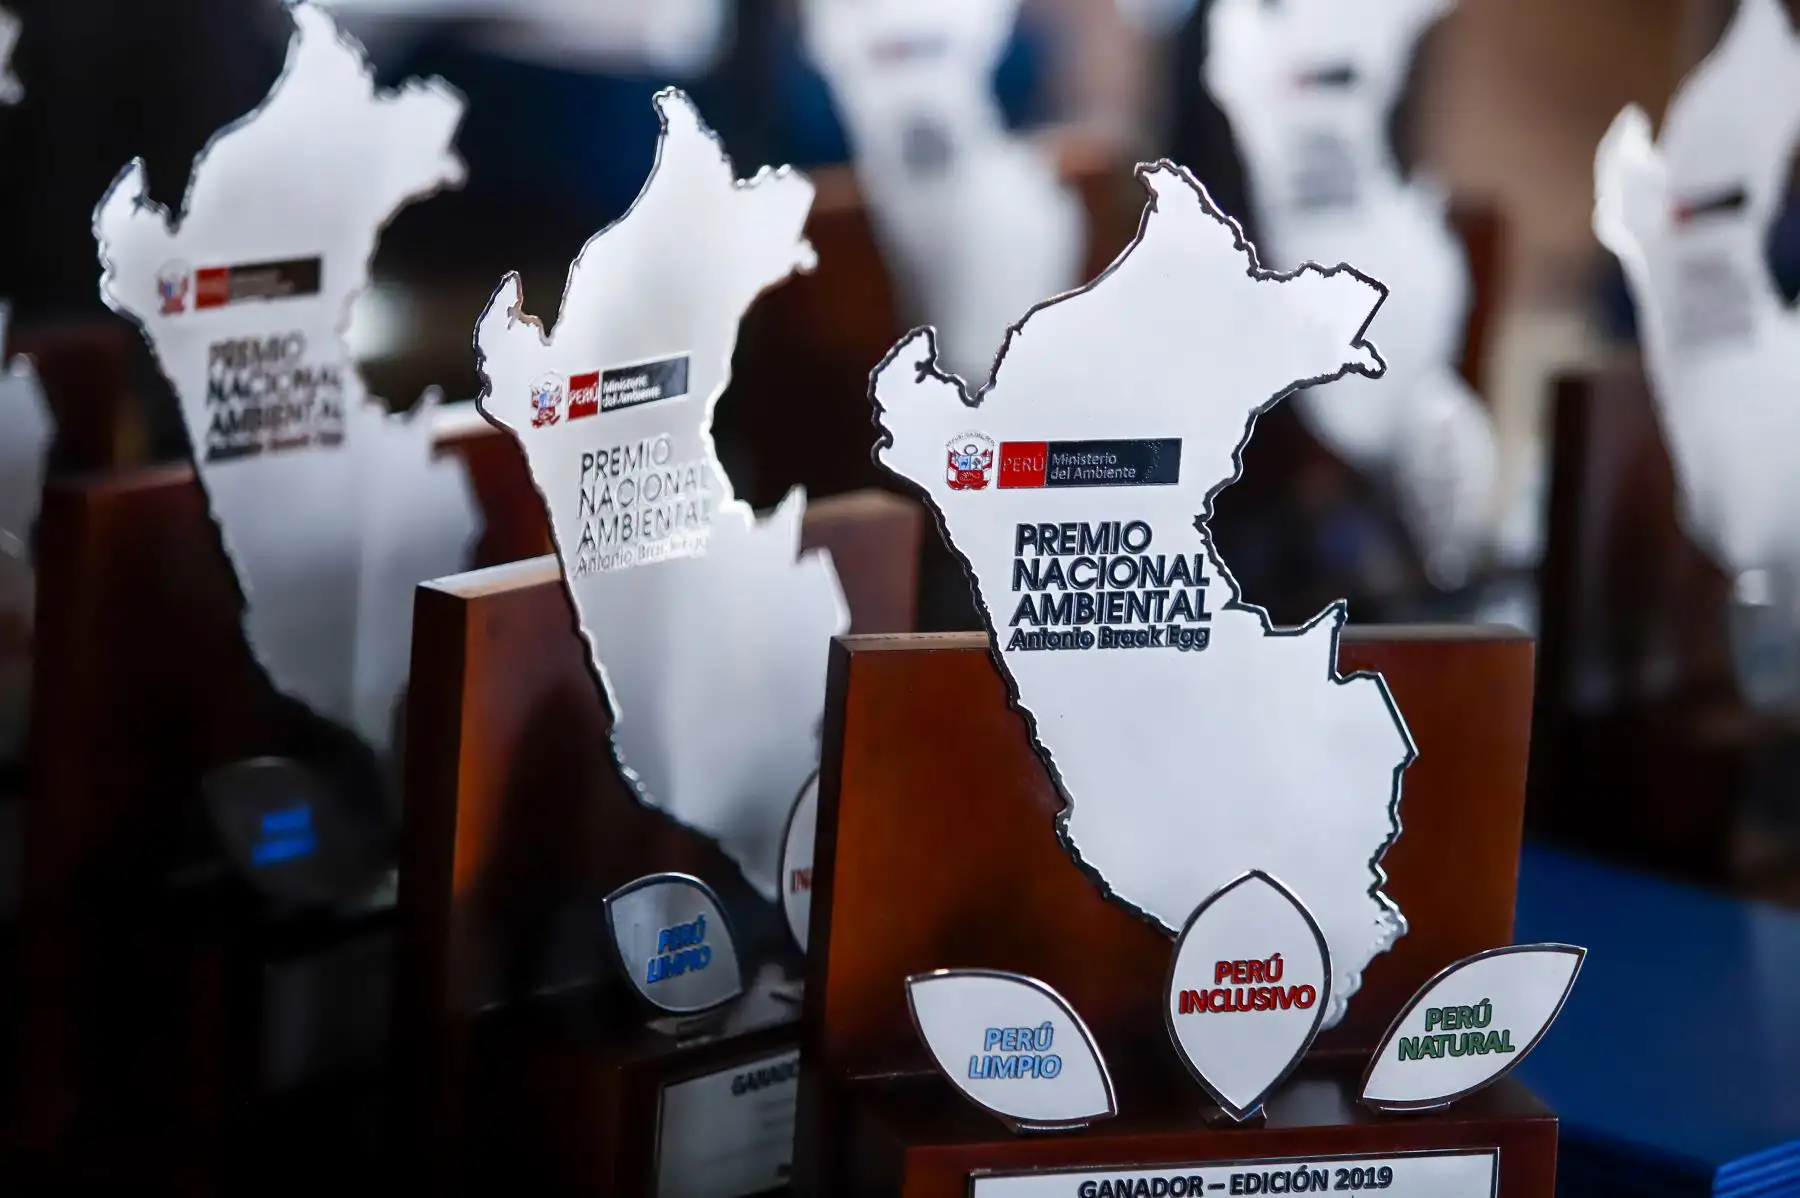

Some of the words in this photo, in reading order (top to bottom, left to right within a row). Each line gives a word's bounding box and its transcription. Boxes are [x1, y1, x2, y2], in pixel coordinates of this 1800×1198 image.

[578, 433, 674, 486] PREMIO
[1001, 452, 1045, 473] PERÚ
[1050, 451, 1117, 466] Ministerio
[1050, 465, 1071, 481] del
[1074, 465, 1136, 480] Ambiente
[575, 460, 710, 520] NACIONAL
[574, 497, 711, 555] AMBIENTAL
[1014, 520, 1153, 557] PREMIO
[1012, 553, 1211, 592] NACIONAL
[1009, 588, 1212, 626] AMBIENTAL
[1006, 626, 1095, 652] Antonio
[1097, 625, 1166, 651] Brack
[1166, 624, 1212, 652] Egg
[646, 943, 712, 984] LIMPIO
[1214, 952, 1284, 985] PERÚ
[1178, 984, 1316, 1015] INCLUSIVO
[1425, 997, 1492, 1032] PERÚ
[983, 1021, 1054, 1051] PERÚ
[1398, 1029, 1515, 1061] NATURAL
[968, 1054, 1063, 1079] LIMPIO
[1078, 1174, 1204, 1198] GANADOR
[1229, 1165, 1329, 1196] EDICIÓN
[1334, 1166, 1394, 1190] 2019
